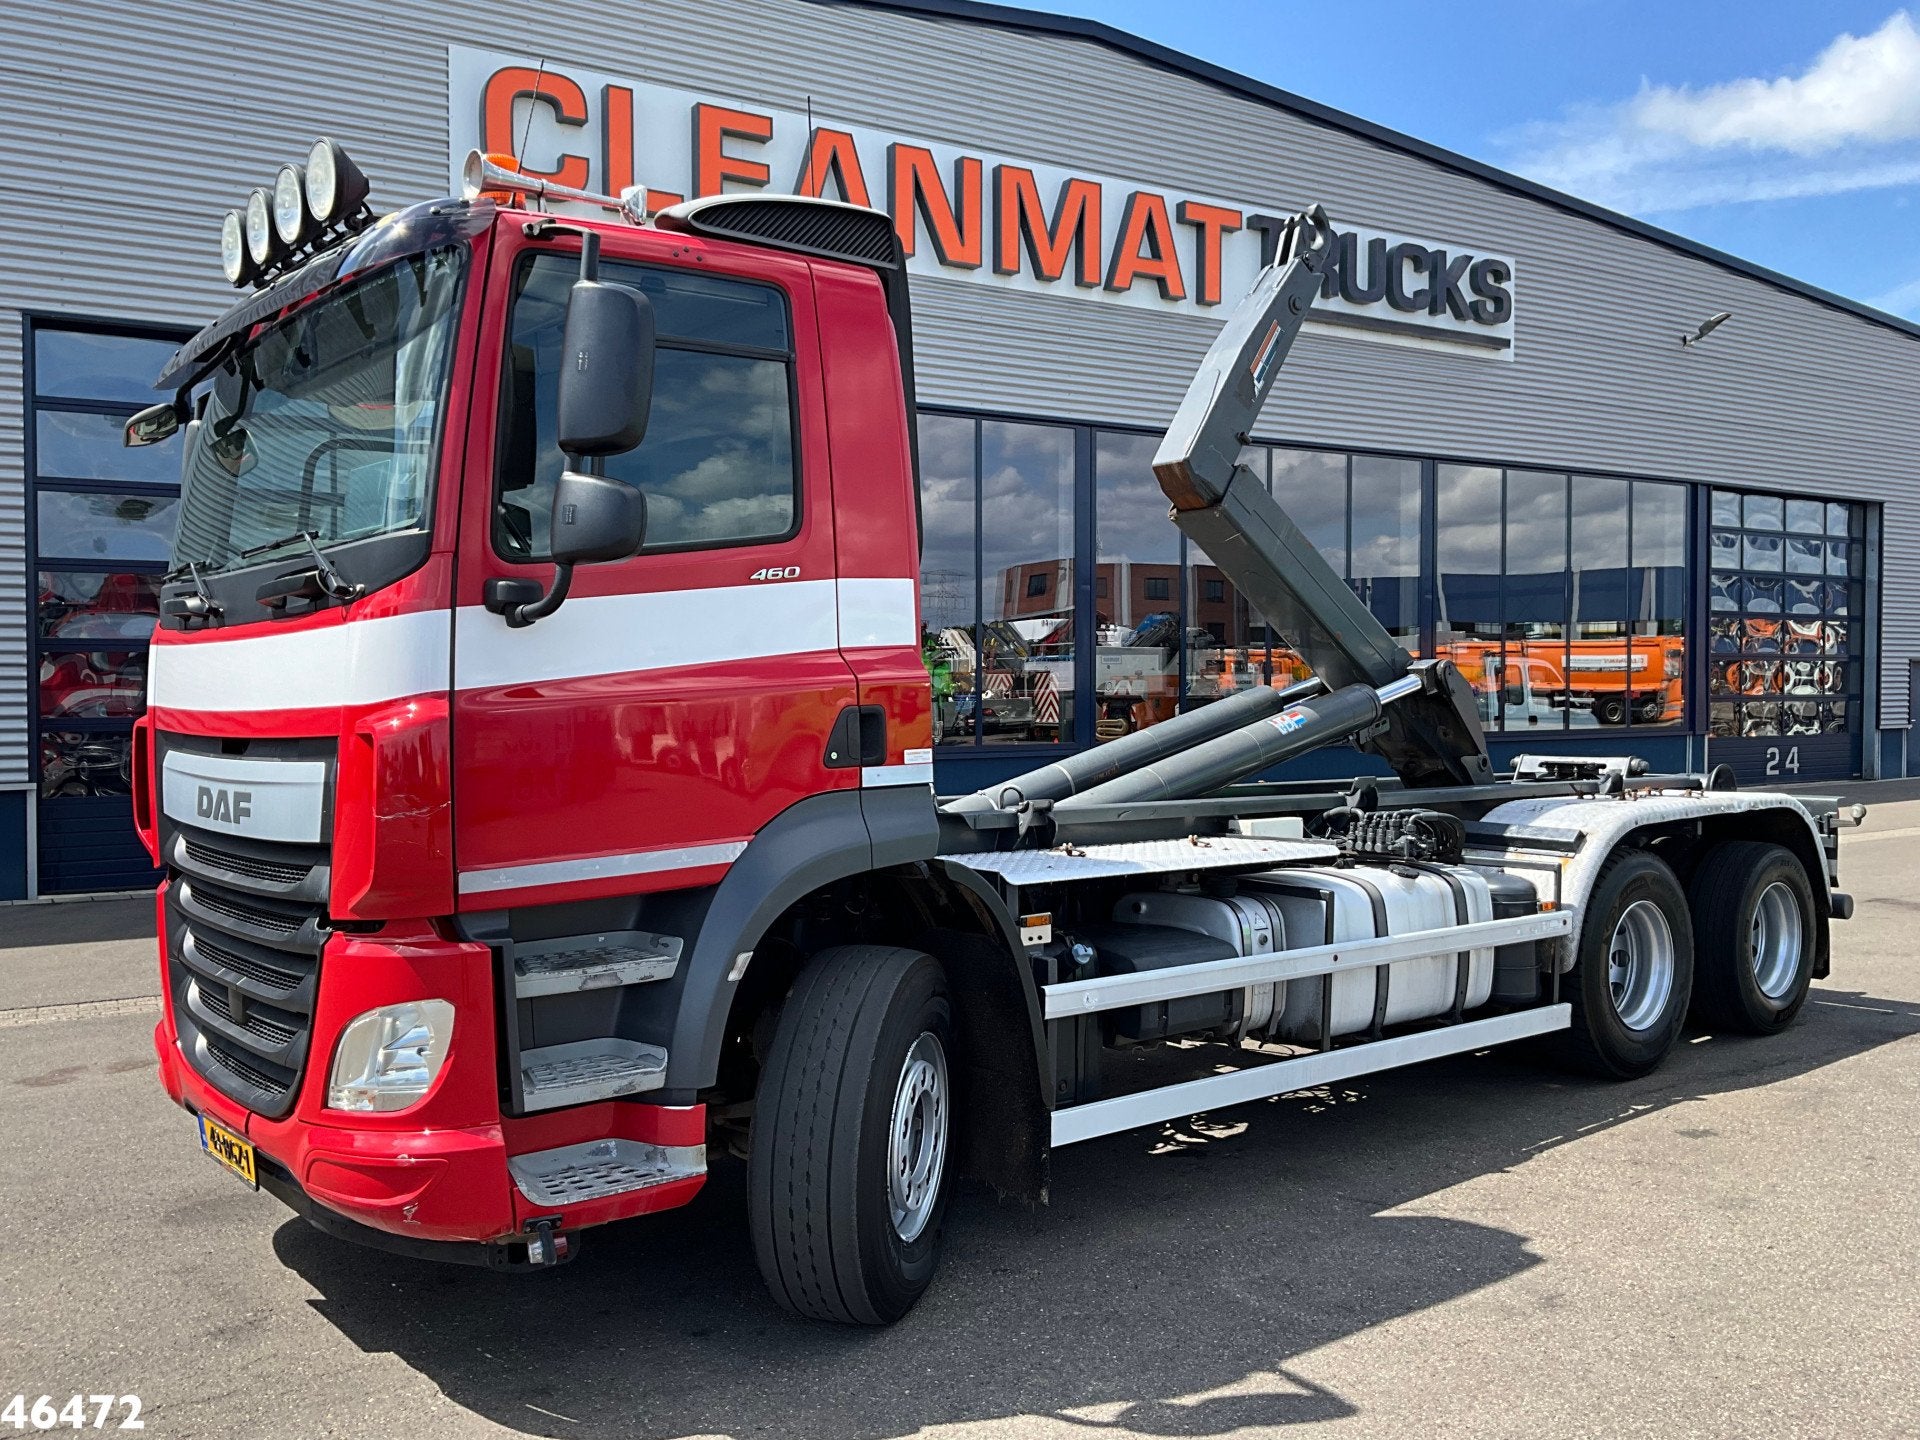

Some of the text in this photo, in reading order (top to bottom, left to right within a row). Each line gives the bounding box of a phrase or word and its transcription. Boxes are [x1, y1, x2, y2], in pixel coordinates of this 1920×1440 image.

[479, 65, 1243, 306] CLEANMAT
[749, 566, 801, 581] 460
[1766, 746, 1800, 776] 24
[197, 785, 252, 824] DAF
